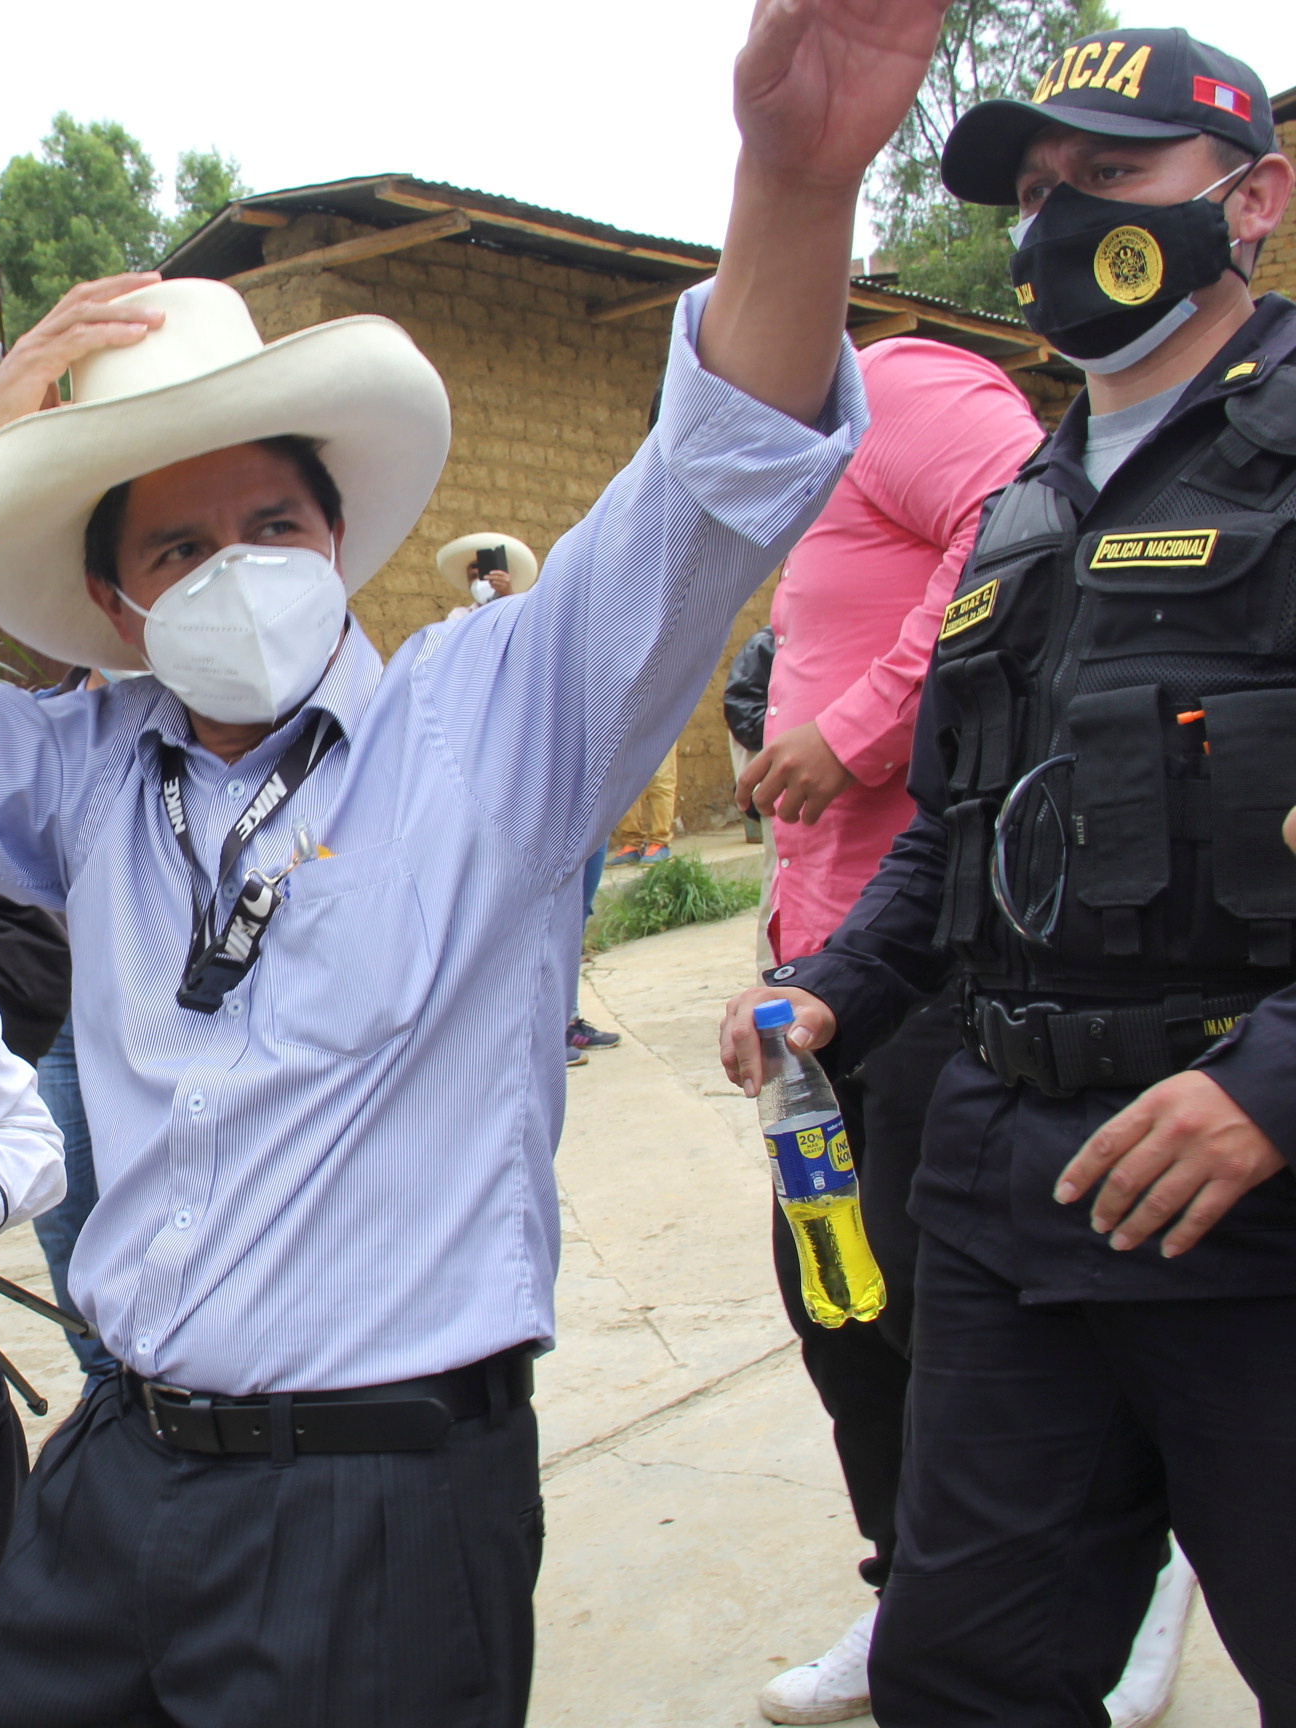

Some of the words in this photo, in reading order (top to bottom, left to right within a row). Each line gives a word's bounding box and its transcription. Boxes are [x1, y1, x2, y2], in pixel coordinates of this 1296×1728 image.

[1032, 41, 1152, 104] LICIA
[1099, 541, 1144, 559] POLICIA
[1144, 538, 1206, 557] NACIONAL
[163, 776, 186, 835] NIKE
[235, 771, 288, 842] NIKE
[799, 1133, 823, 1145] 20%
